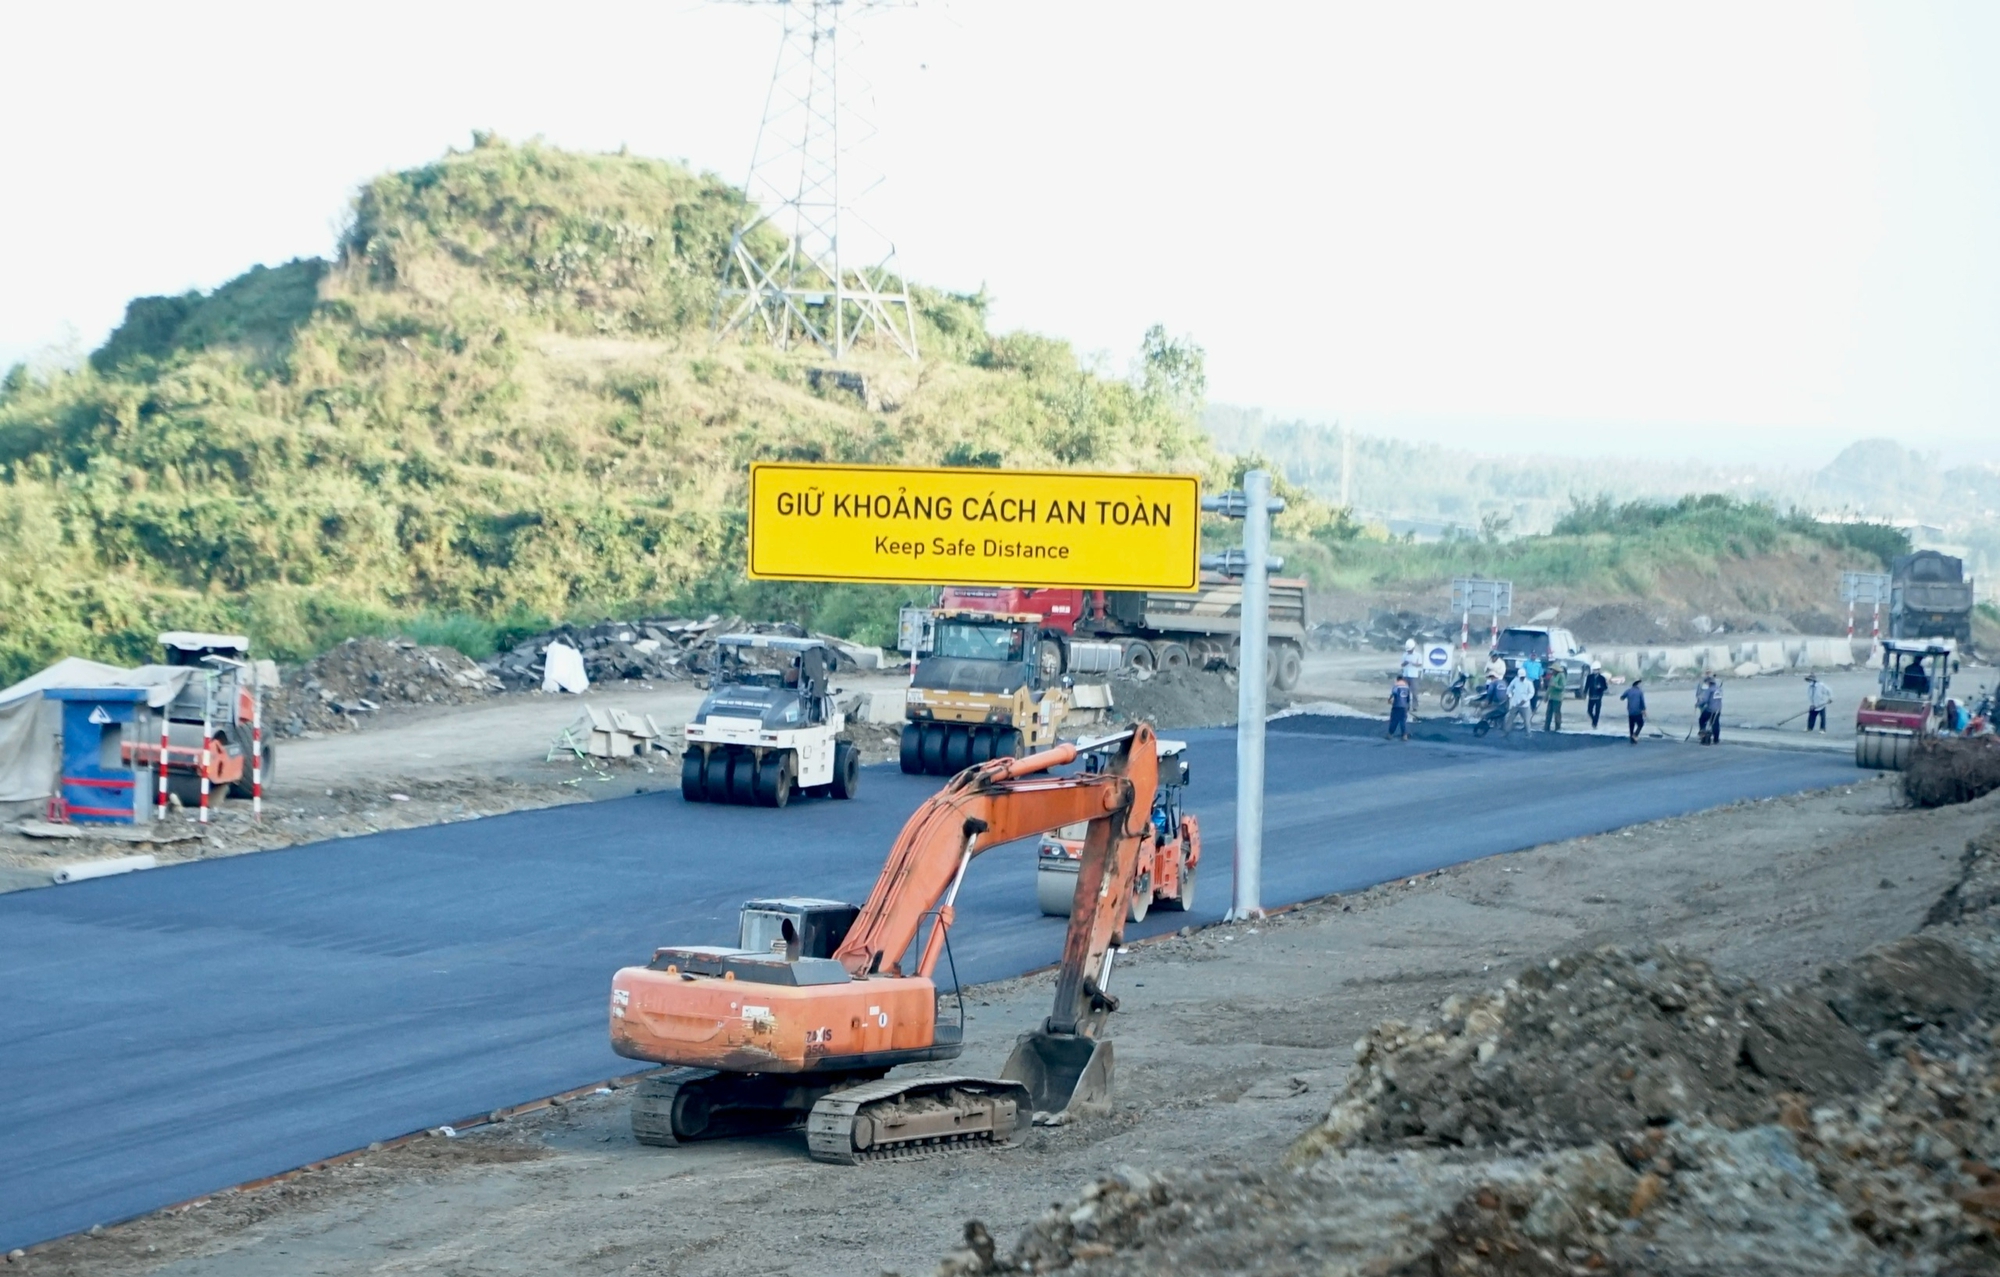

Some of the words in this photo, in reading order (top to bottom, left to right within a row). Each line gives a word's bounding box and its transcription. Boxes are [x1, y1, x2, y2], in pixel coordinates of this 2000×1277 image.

[777, 486, 825, 517] GIỮ
[834, 487, 953, 521] KHOẢNG
[962, 491, 1036, 523] CÁCH
[1045, 499, 1086, 525] AN
[1095, 495, 1172, 527] TOÀN
[875, 536, 925, 559] Keep
[932, 538, 976, 556] Safe
[983, 539, 1070, 559] Distance
